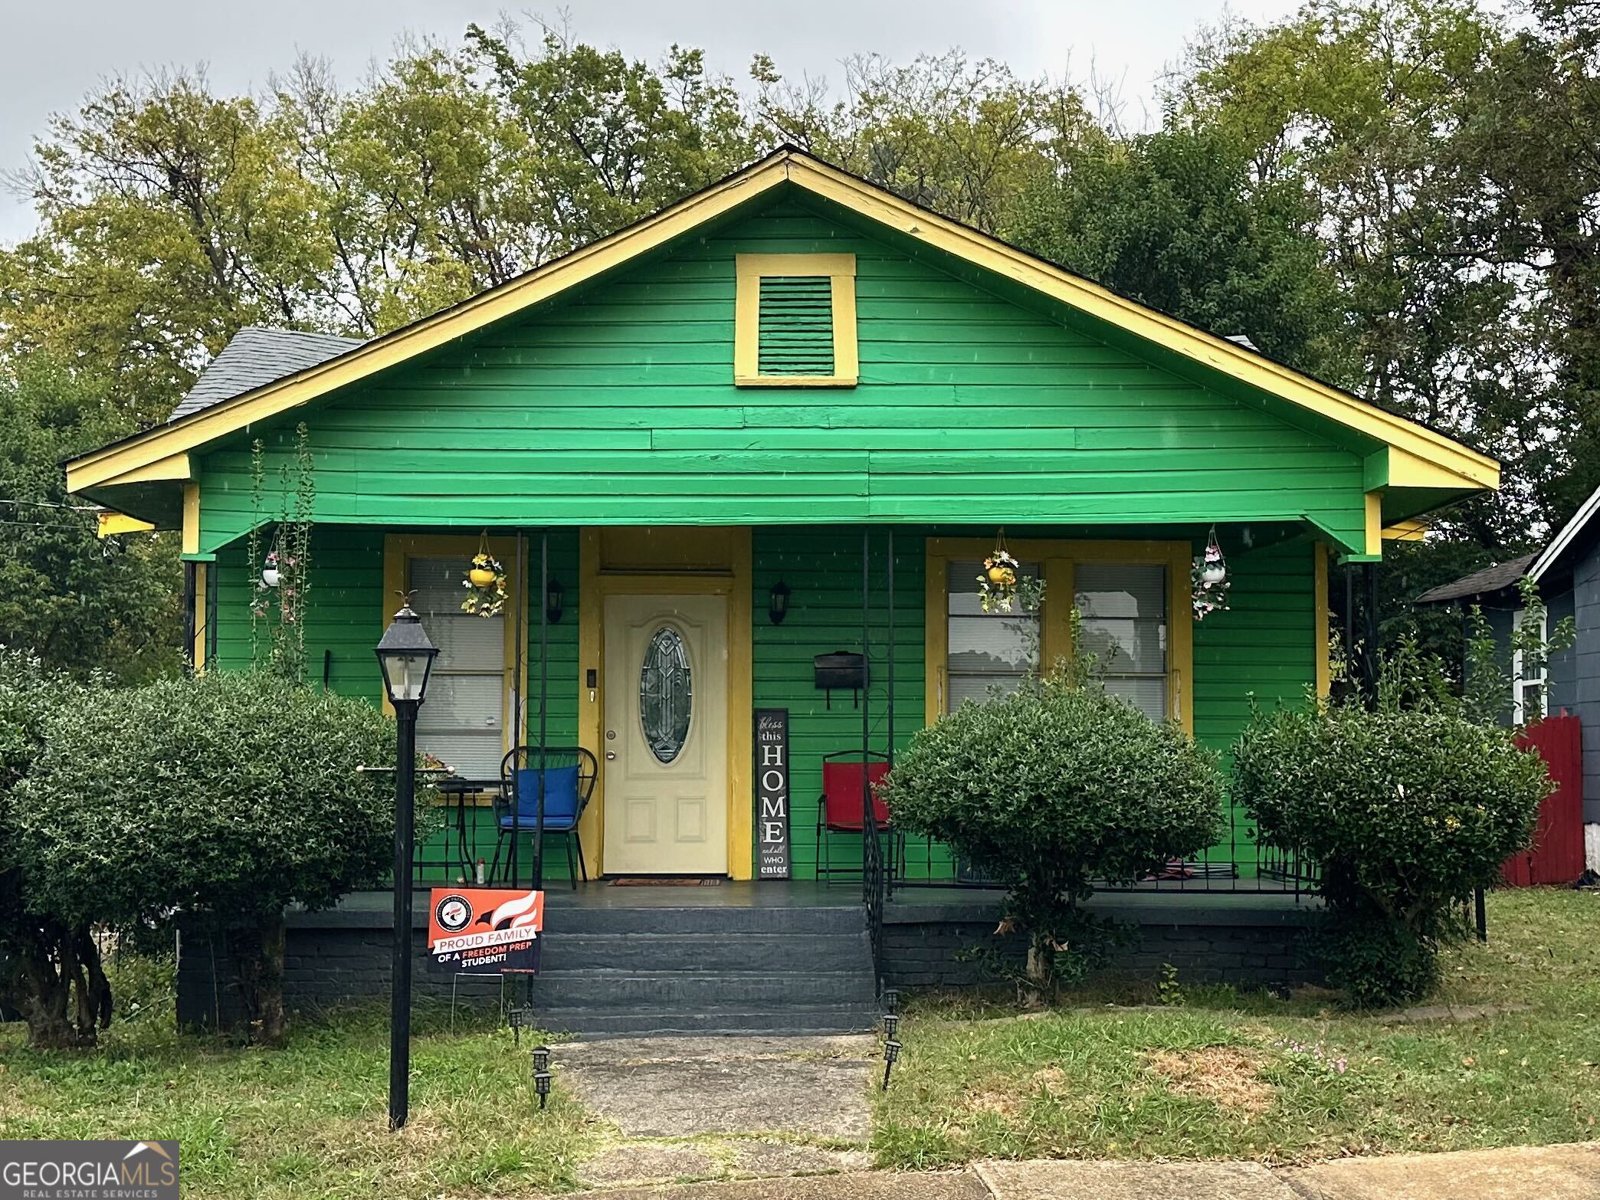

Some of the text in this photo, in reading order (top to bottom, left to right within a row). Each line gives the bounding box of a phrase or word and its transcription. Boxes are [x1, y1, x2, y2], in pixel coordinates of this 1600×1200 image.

[762, 731, 782, 741] this
[761, 745, 786, 843] HOME
[763, 856, 784, 864] WHO
[760, 866, 787, 874] enter
[439, 928, 532, 951] PROUD FAMILY
[437, 941, 532, 963] OF A FREEDOM PREP
[461, 953, 507, 968] STUDENT!
